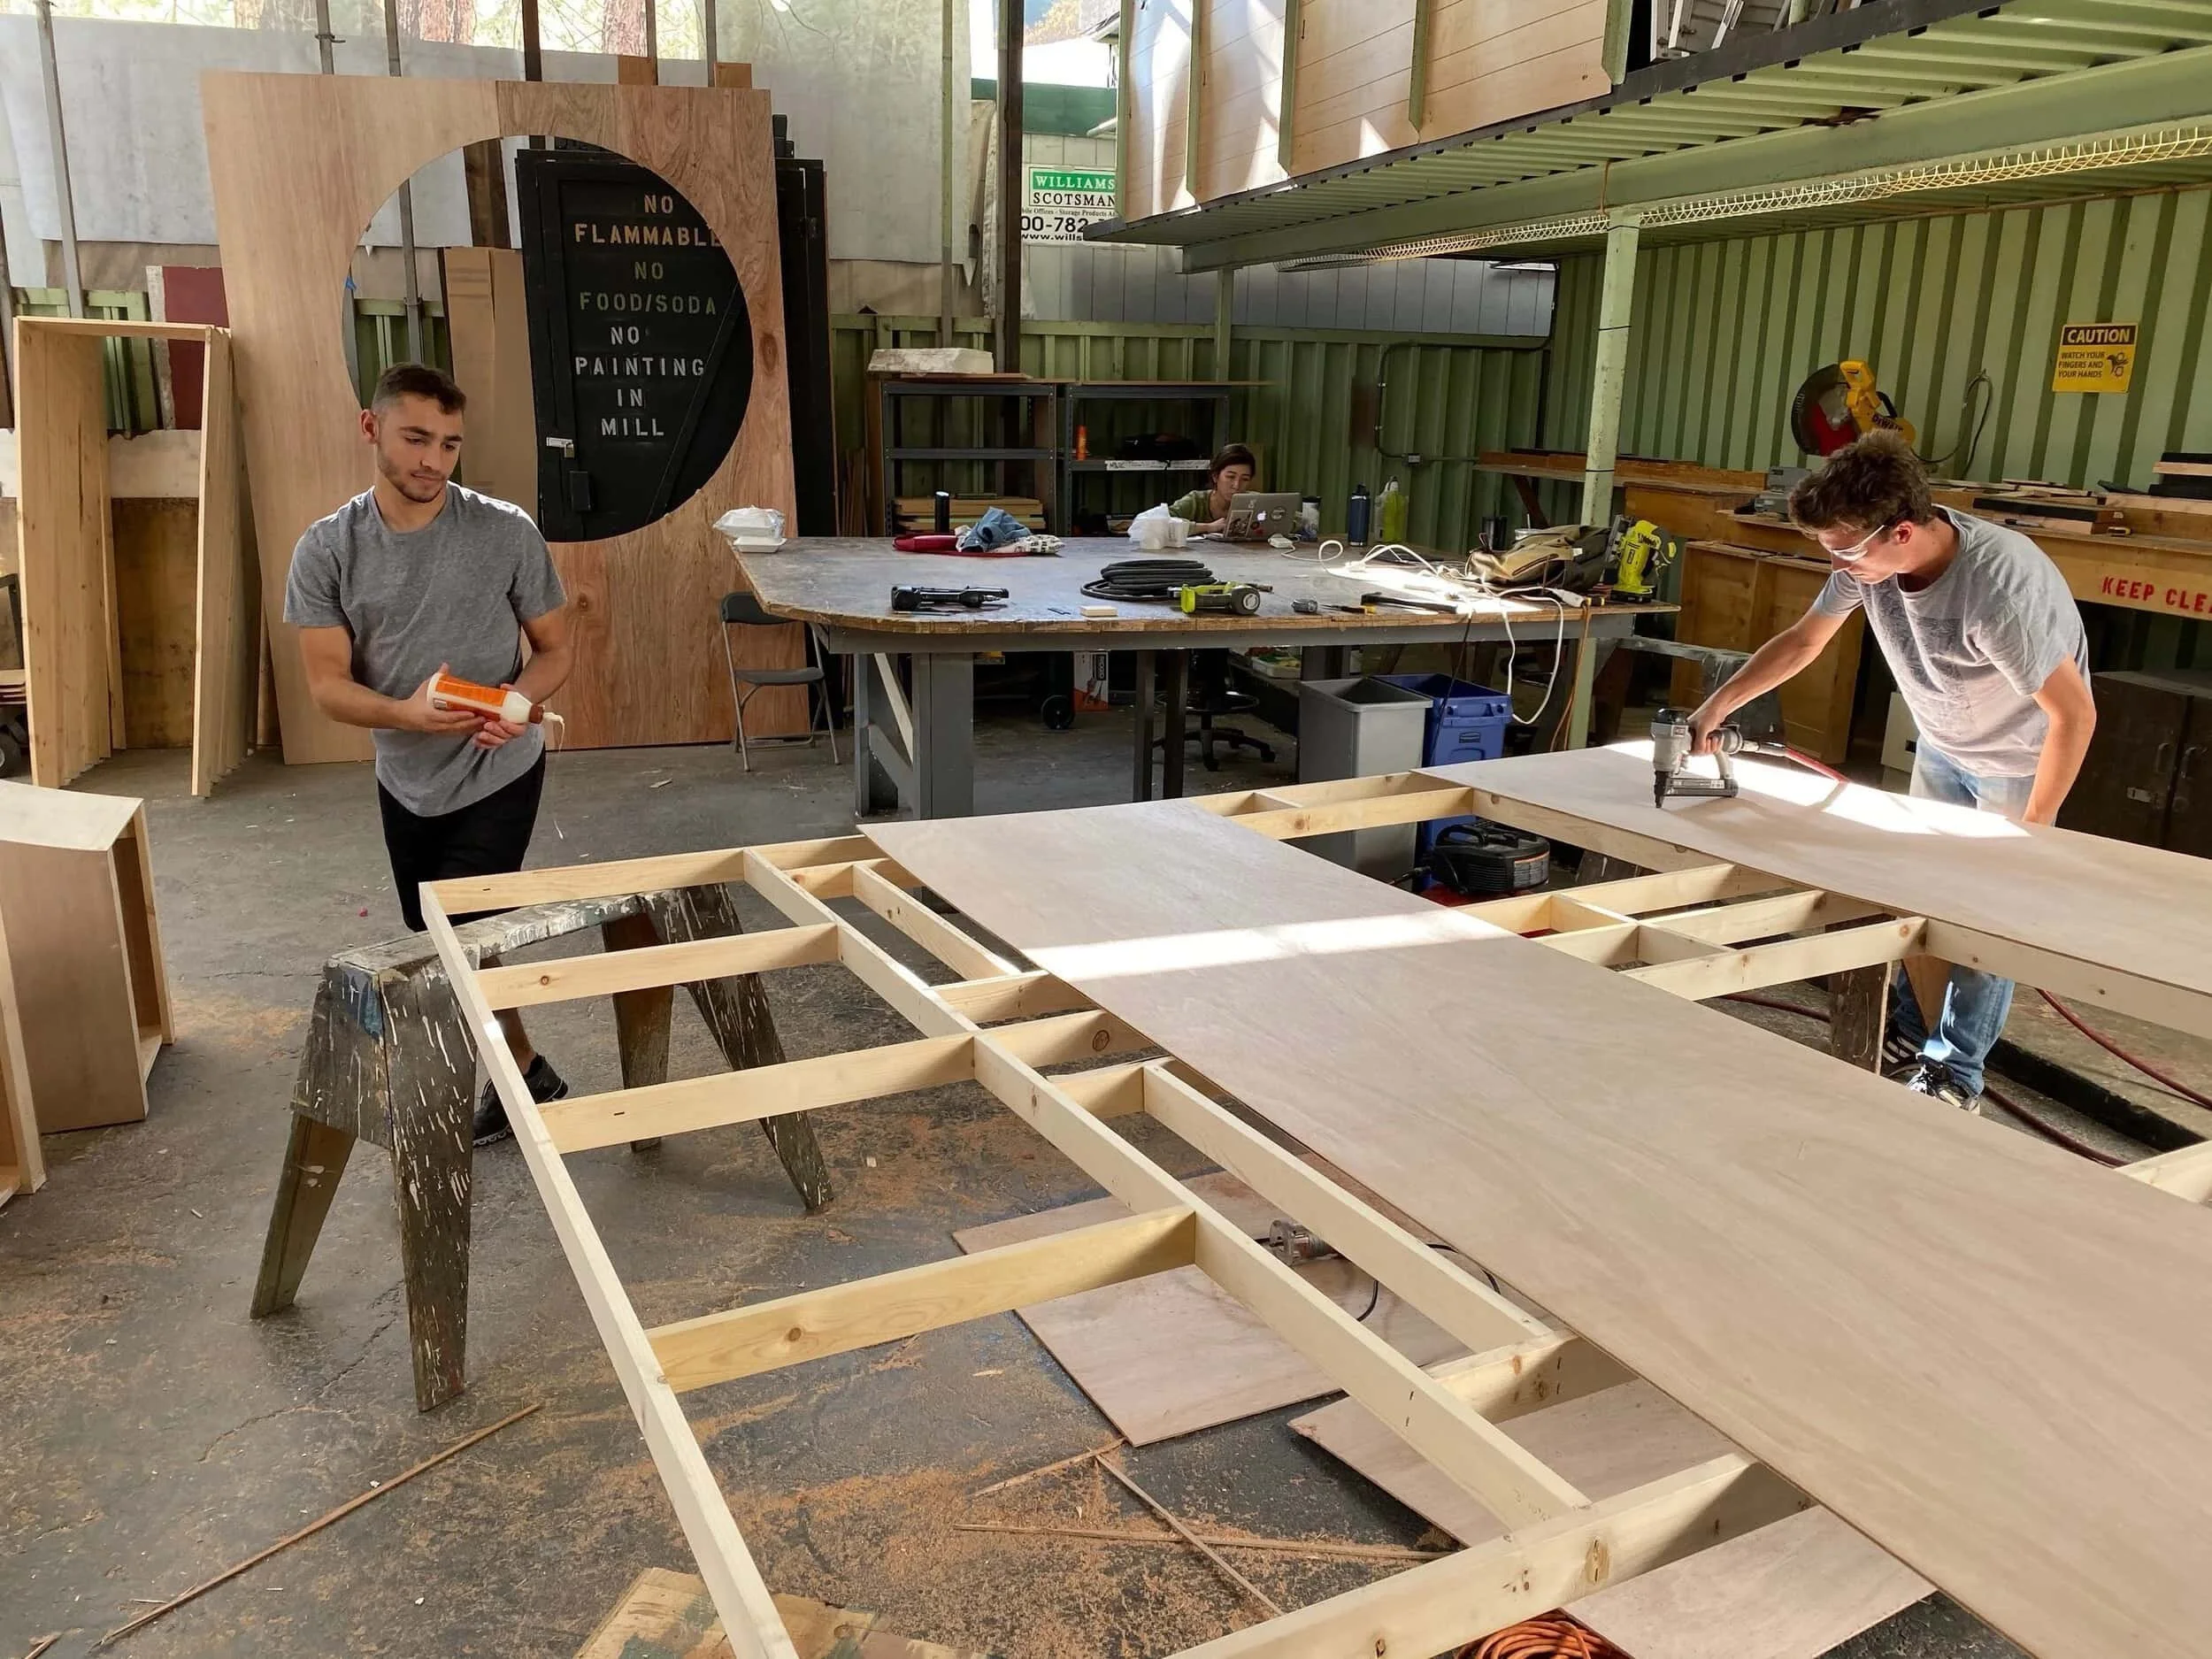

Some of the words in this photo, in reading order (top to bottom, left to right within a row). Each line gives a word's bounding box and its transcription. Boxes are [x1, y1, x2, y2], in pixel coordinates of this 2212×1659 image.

[1034, 175, 1116, 190] WILLIAMS
[644, 195, 673, 214] NO
[1033, 192, 1116, 207] SCOTSMAN
[634, 262, 664, 280] NO
[580, 291, 717, 315] FOOD/SODA
[611, 326, 640, 344] NO
[2067, 328, 2131, 343] CAUTION
[575, 357, 704, 376] PAINTING
[617, 389, 643, 407] IN
[601, 419, 664, 436] MILL
[2101, 577, 2154, 602] KEEP
[2165, 588, 2212, 614] CLE
